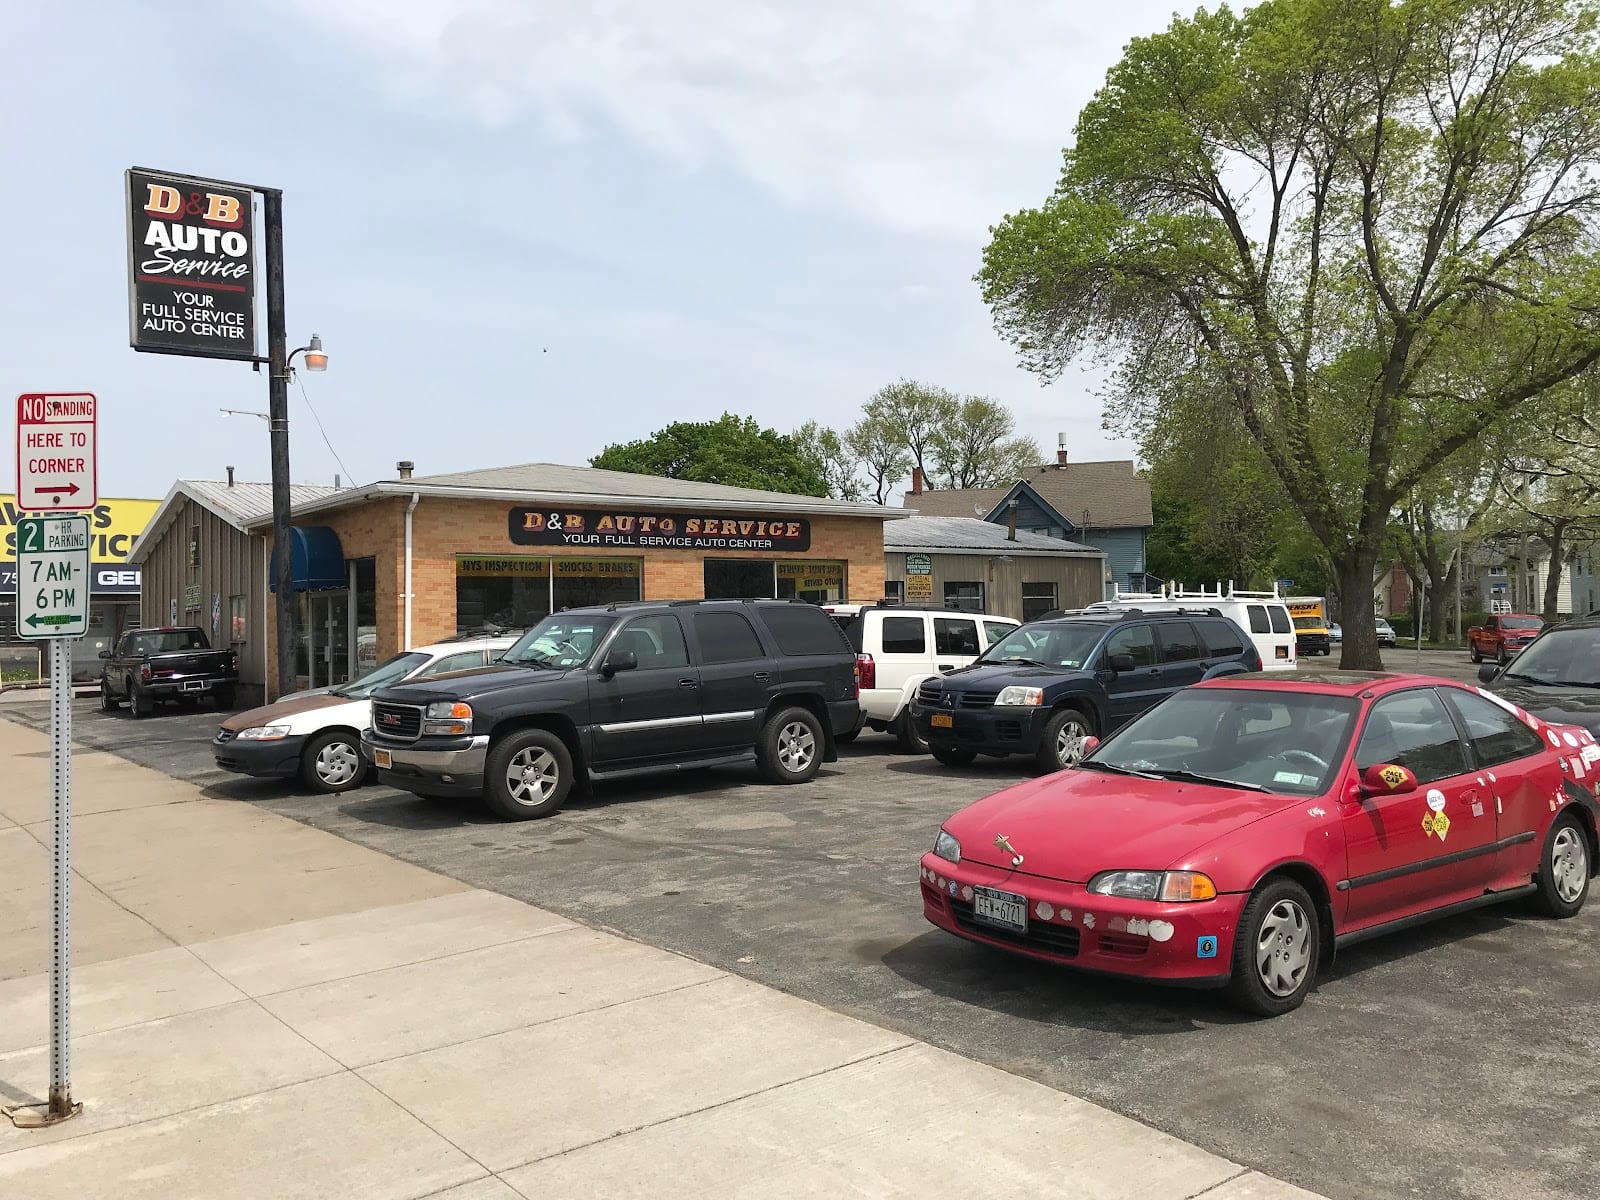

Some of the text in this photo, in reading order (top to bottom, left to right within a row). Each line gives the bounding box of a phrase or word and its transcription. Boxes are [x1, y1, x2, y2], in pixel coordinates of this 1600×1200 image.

[144, 184, 243, 226] D&B
[143, 220, 248, 258] AUTO
[141, 246, 250, 279] Service
[173, 290, 215, 308] YOUR
[142, 302, 245, 326] FULL SERVICE
[143, 317, 245, 339] AUTO CENTER
[22, 398, 93, 421] NO STANDING
[27, 432, 86, 448] HERE TO
[29, 458, 85, 473] CORNER
[24, 522, 38, 551] 2
[61, 521, 72, 534] HR
[523, 512, 801, 539] D&B AUTO SERVICE
[49, 534, 84, 548] PARKING
[563, 534, 772, 549] YOUR FULL SERVICE AUTO CENTER
[462, 560, 634, 573] NYS INSPECTION SHOCKS BRAKES
